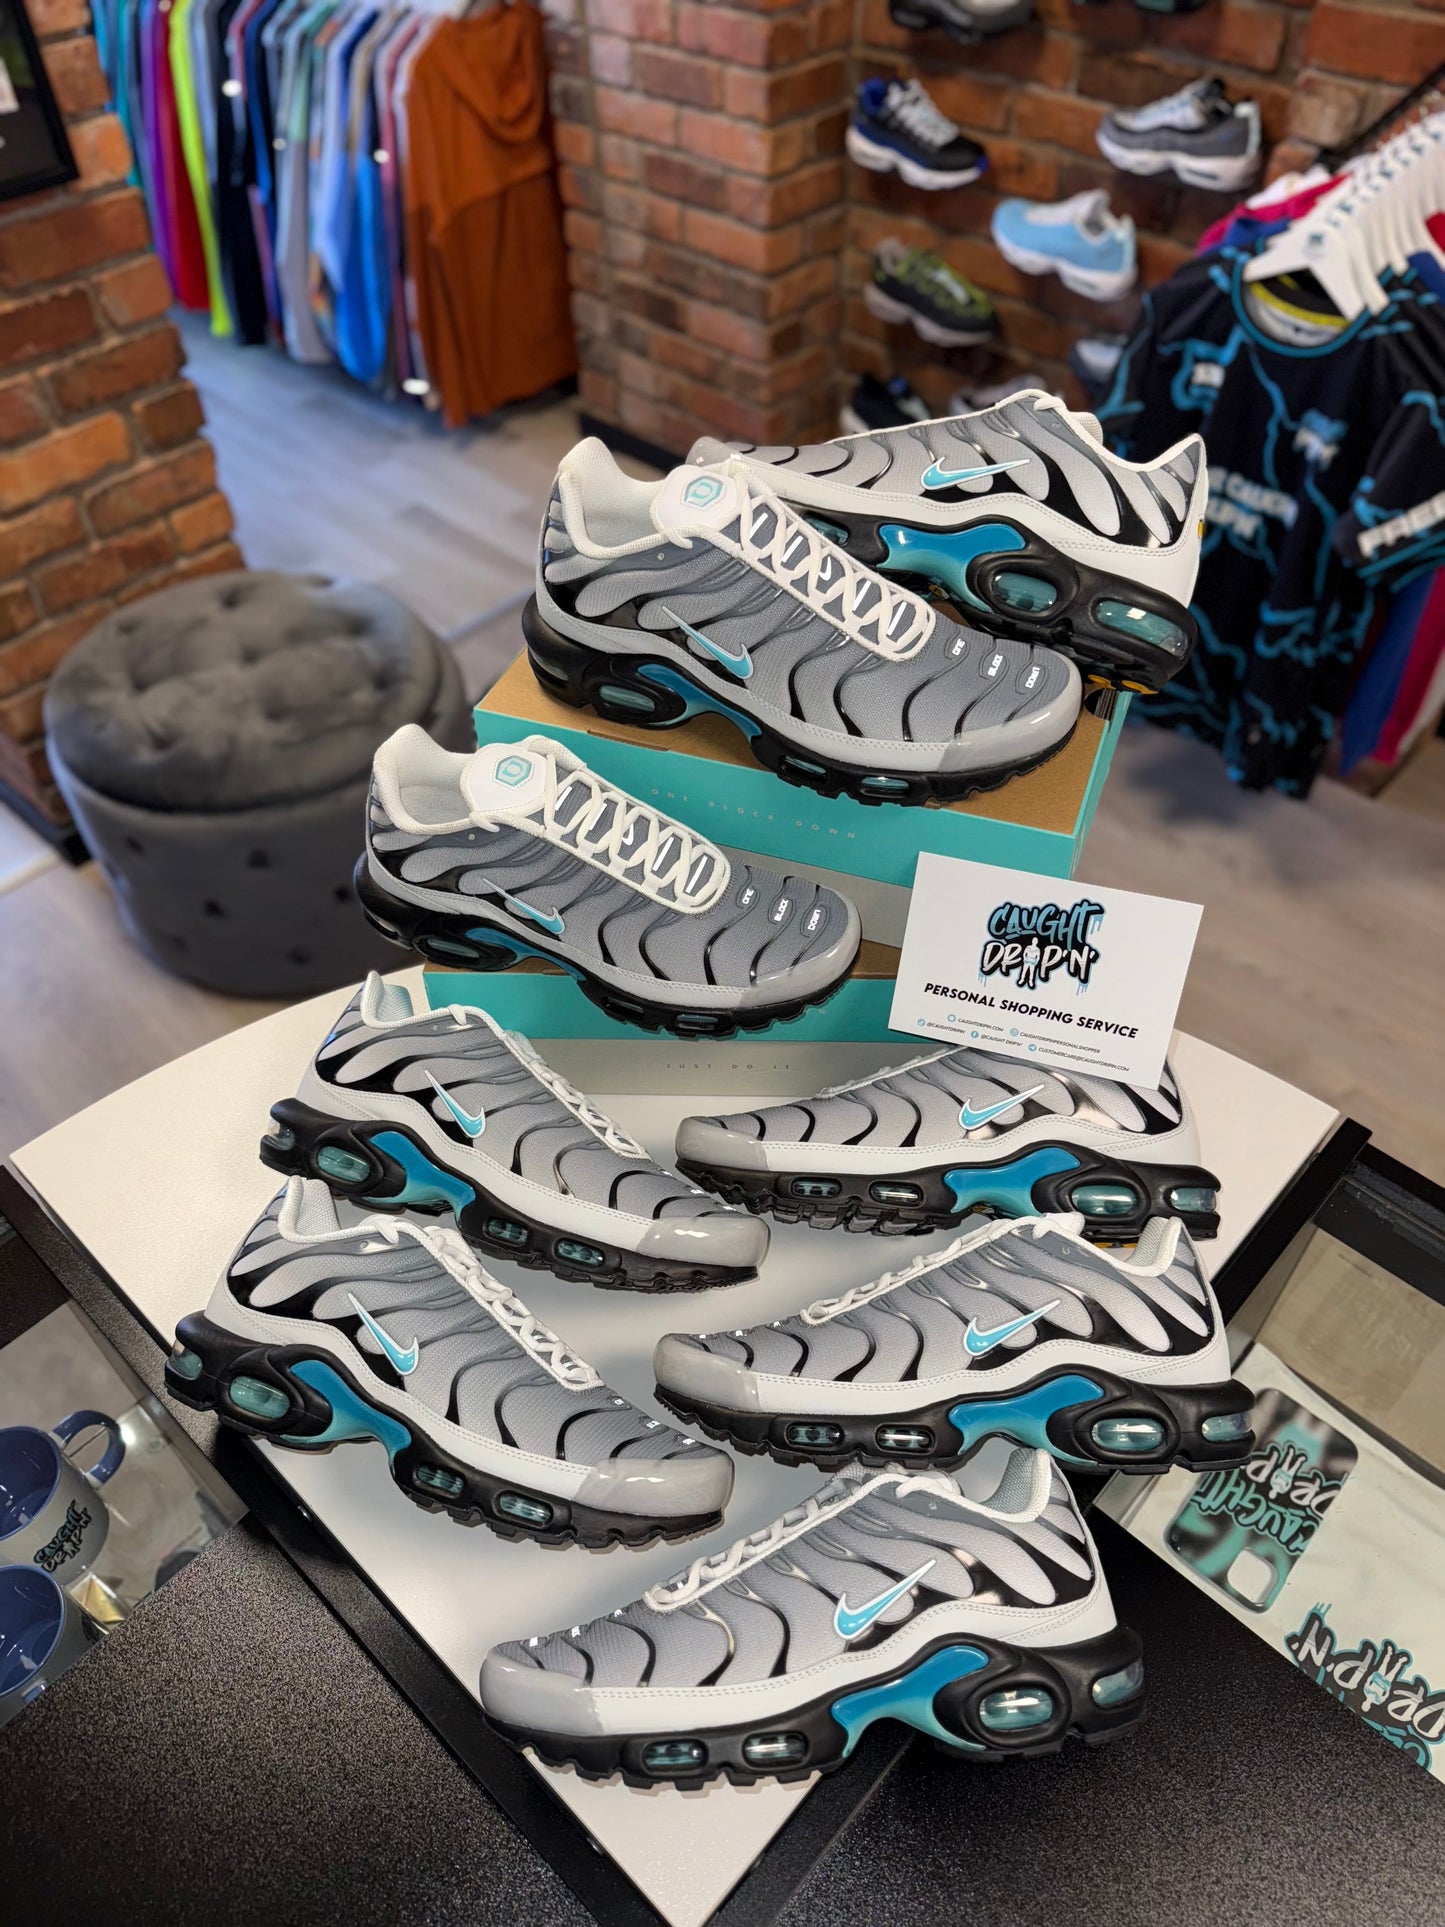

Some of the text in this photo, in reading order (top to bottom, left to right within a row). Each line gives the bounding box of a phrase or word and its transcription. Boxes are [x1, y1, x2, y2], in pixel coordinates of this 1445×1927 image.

[709, 801, 774, 820] BLOCK
[795, 820, 856, 839] DOWN
[988, 899, 1103, 951] CAUGHT
[924, 982, 1139, 1039] PERSONAL SHOPPING SERVICE
